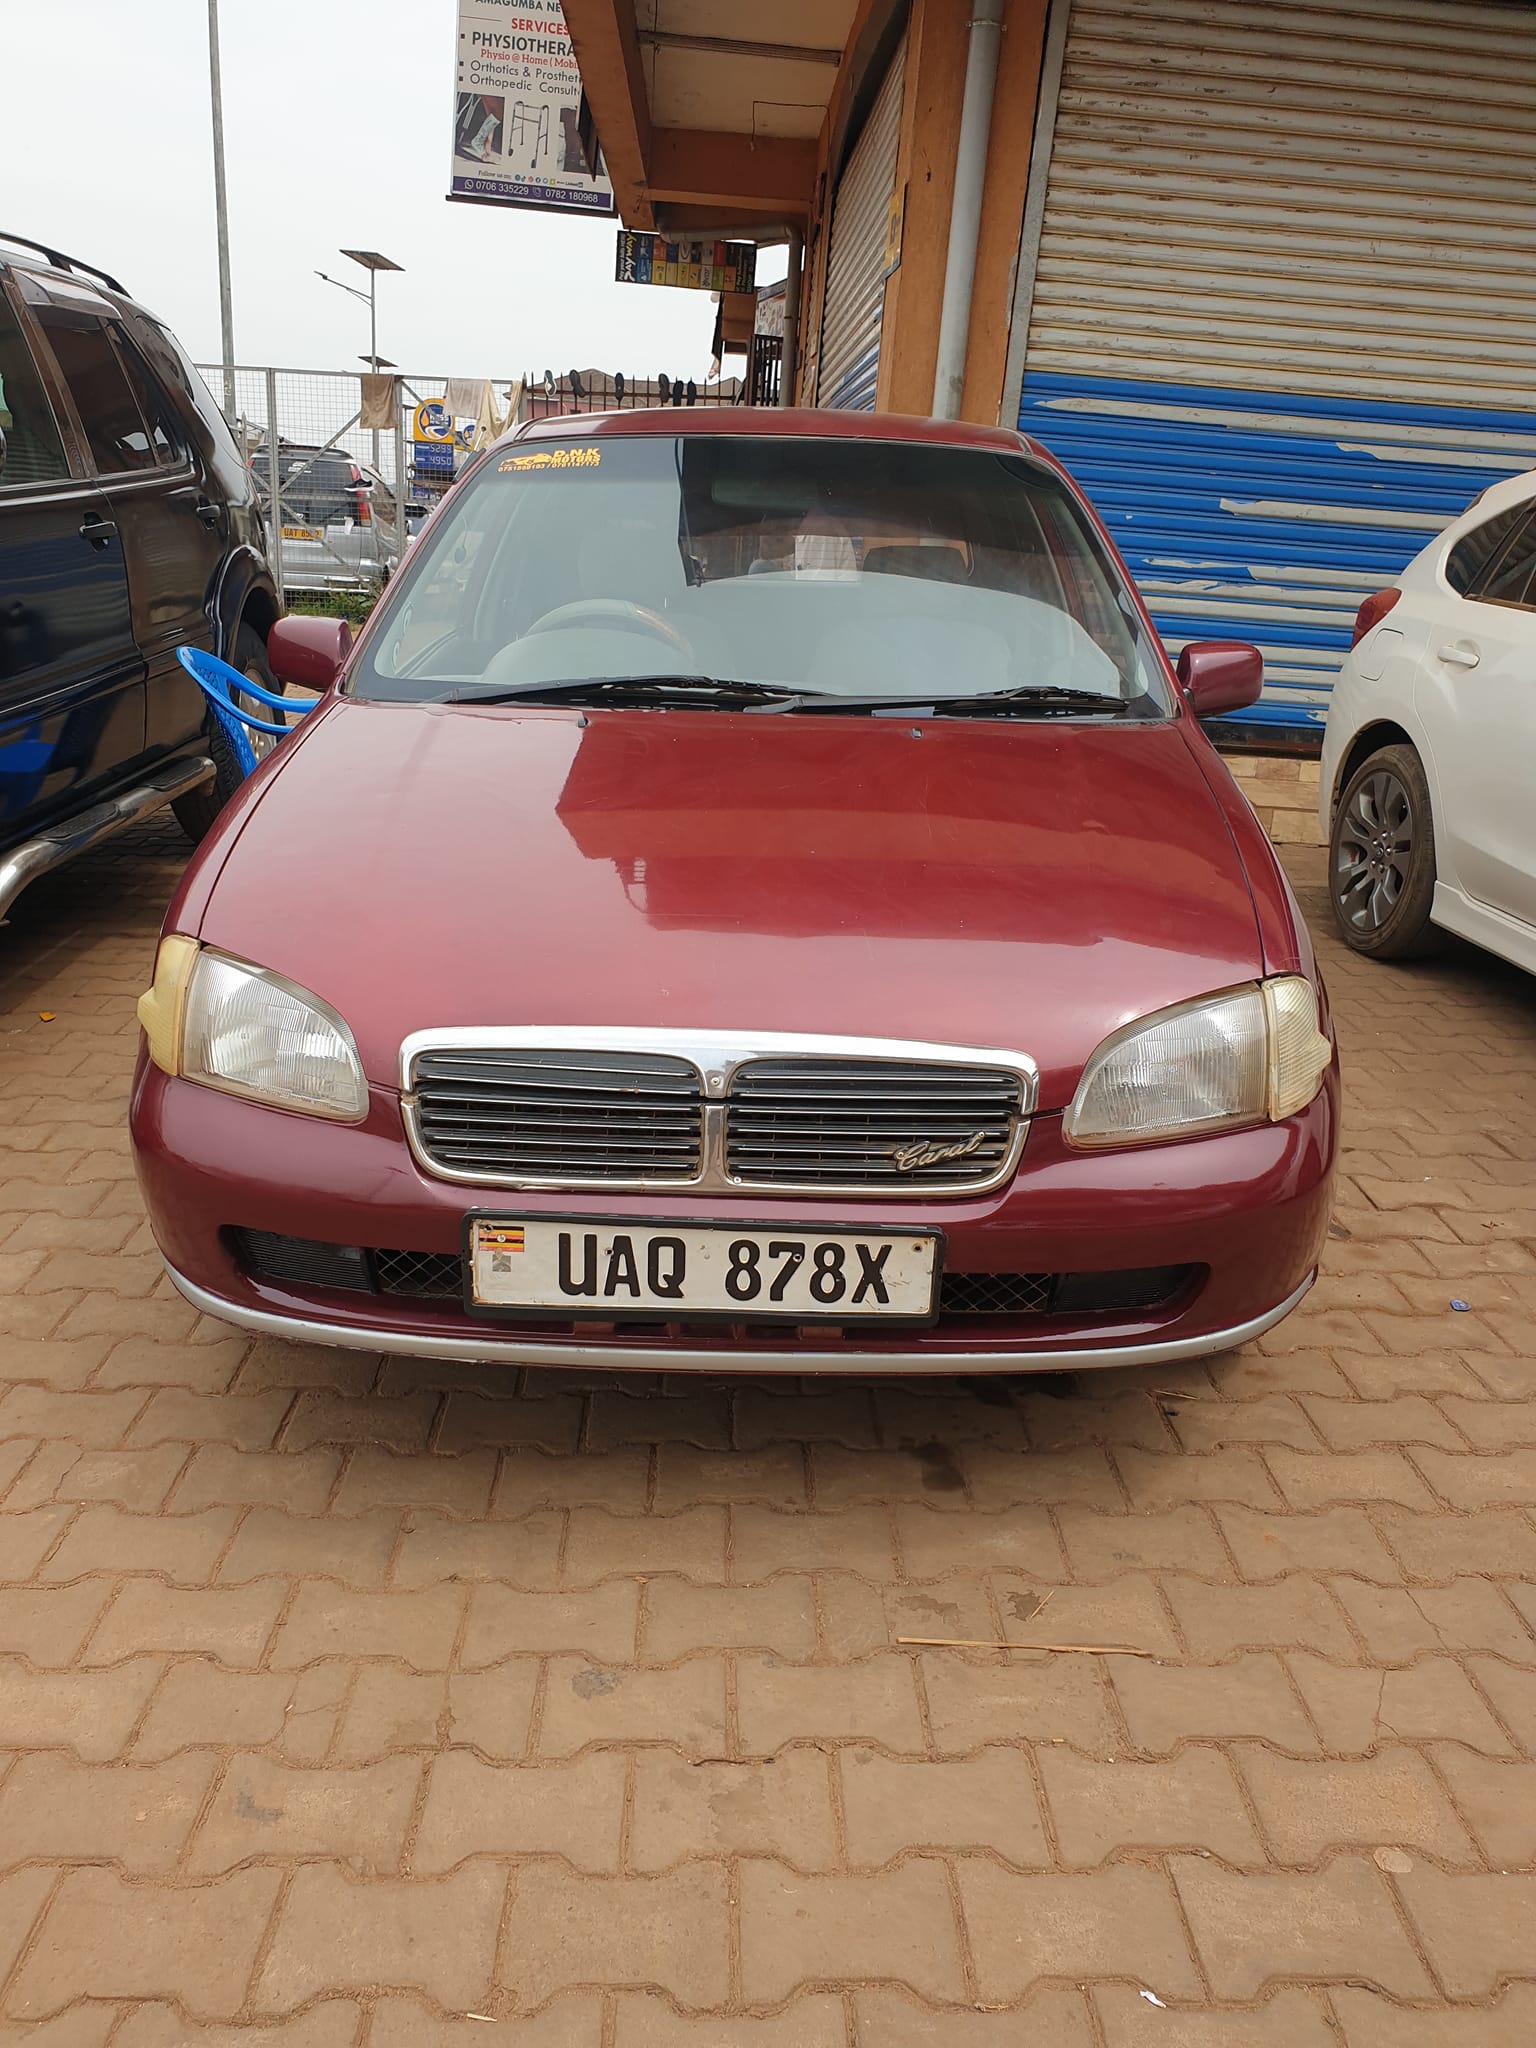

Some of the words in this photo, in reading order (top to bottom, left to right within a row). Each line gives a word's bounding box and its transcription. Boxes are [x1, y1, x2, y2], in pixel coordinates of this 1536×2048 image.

[474, 0, 543, 10] AGUMBA
[547, 2, 560, 13] NE
[511, 18, 569, 35] SERVICES
[480, 49, 511, 61] Physio
[511, 53, 521, 63] @
[522, 54, 548, 66] Home
[470, 60, 519, 76] Orthotics
[522, 66, 531, 77] &
[470, 73, 532, 90] Orthopedic
[475, 181, 497, 191] 0706
[499, 183, 529, 195] 335229
[545, 189, 566, 199] 0782
[569, 191, 598, 203] 180968
[430, 443, 452, 454] 5299
[430, 455, 452, 466] 4950
[550, 454, 601, 464] MOTORS
[284, 528, 298, 537] UAT
[558, 1231, 687, 1299] UAQ
[724, 1239, 893, 1304] 878X
